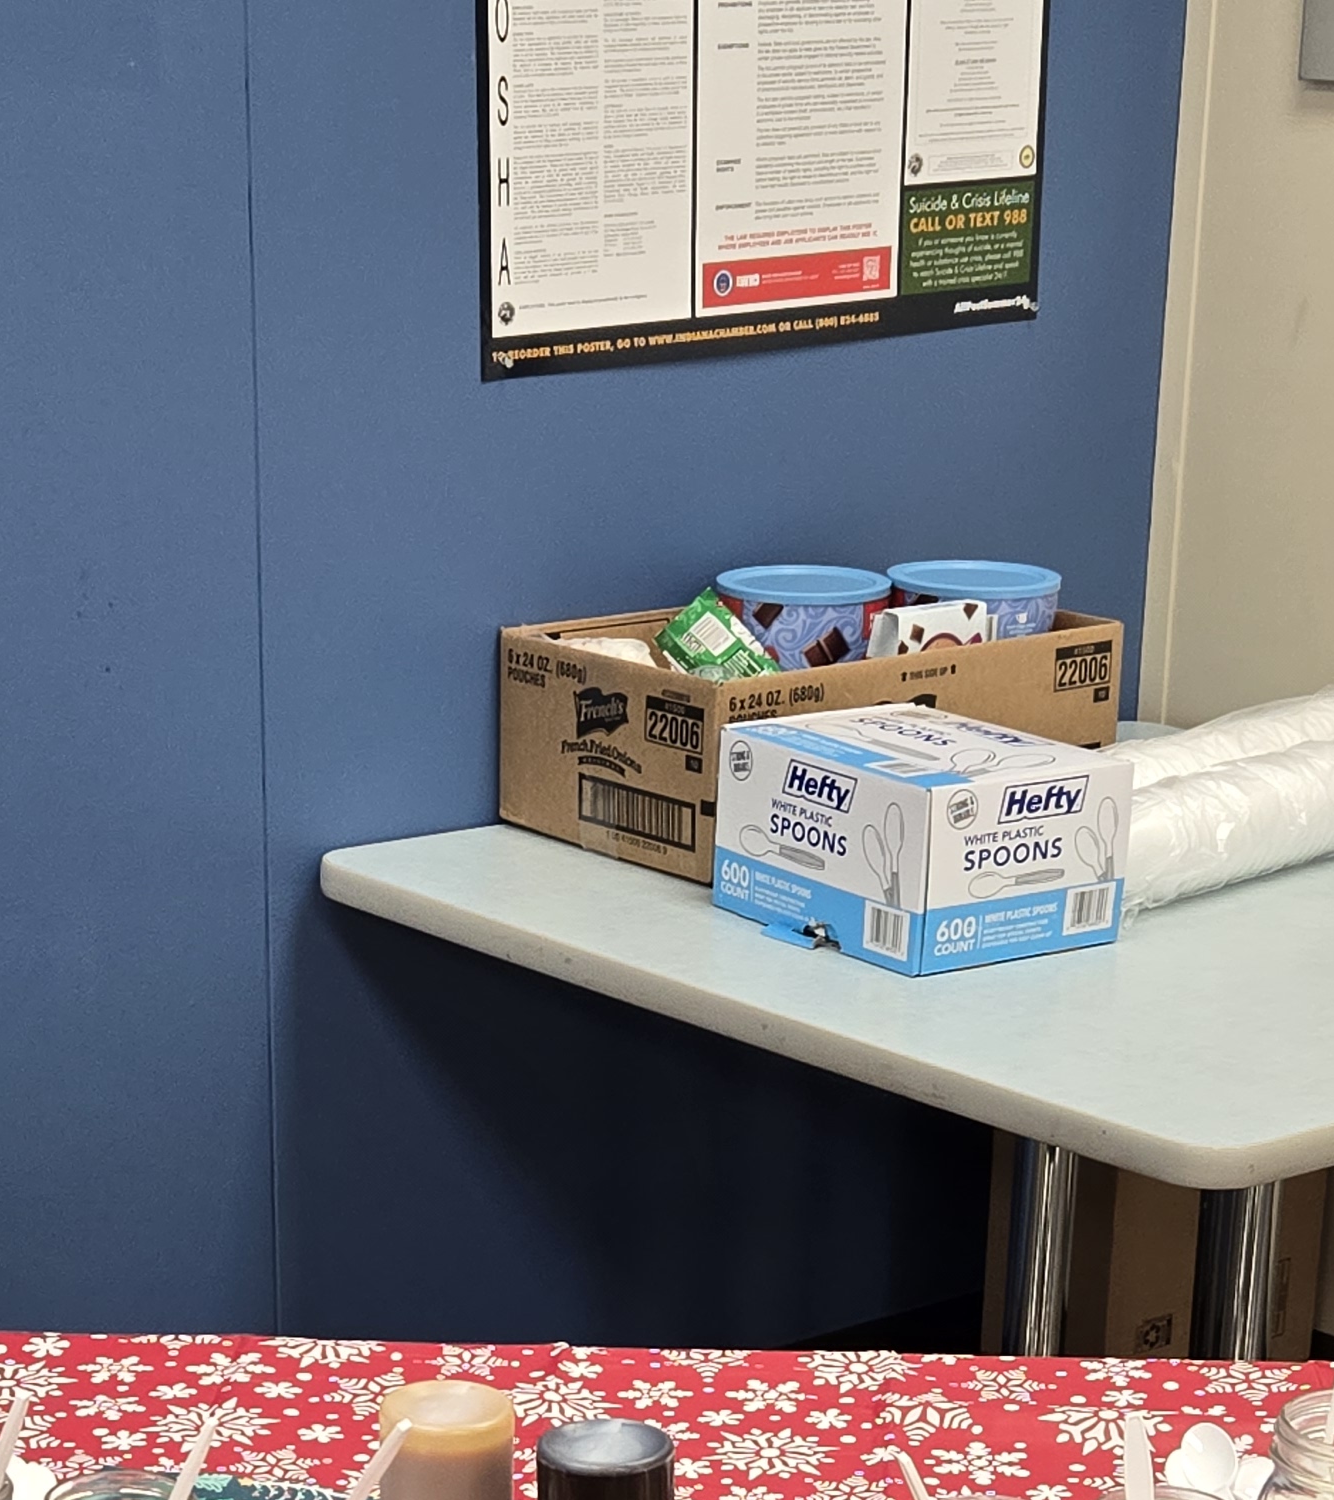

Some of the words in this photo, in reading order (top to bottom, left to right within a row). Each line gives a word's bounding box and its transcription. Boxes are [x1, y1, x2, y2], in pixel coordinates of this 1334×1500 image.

[909, 195, 947, 214] Suicide
[950, 194, 959, 210] &
[962, 191, 991, 209] Crisis
[994, 188, 1030, 206] Lifeline
[910, 216, 942, 233] CALL
[945, 213, 965, 230] OR
[968, 210, 1000, 228] TEXT
[1003, 208, 1027, 225] 988
[553, 344, 575, 355] THIS
[577, 340, 614, 353] POSTER,
[617, 338, 631, 349] GO
[634, 336, 646, 347] TO
[778, 321, 791, 332] OR
[793, 318, 813, 331] CALL
[508, 649, 514, 662] 6
[522, 652, 535, 669] 24
[556, 660, 587, 685] (680g)
[508, 666, 546, 688] POUCHES
[1058, 655, 1108, 688] 22006
[579, 697, 624, 723] French's
[729, 696, 736, 712] 6
[748, 693, 763, 709] 24
[766, 689, 785, 708] OZ.
[789, 683, 825, 703] (680g)
[648, 710, 700, 750] 22006
[561, 739, 588, 754] French
[588, 739, 612, 758] Fried
[612, 746, 642, 774] Onions
[788, 765, 850, 810] Hefty
[1004, 785, 1082, 817] Hefty
[771, 797, 797, 817] WHITE
[799, 807, 832, 827] PLASTIC
[770, 814, 847, 857] SPOONS
[964, 830, 998, 846] WHITE
[1002, 825, 1045, 842] PLASTIC
[963, 837, 1063, 871] SPOONS
[721, 859, 749, 887] 600
[720, 881, 749, 900] COUNT
[936, 916, 976, 942] 600
[934, 939, 974, 956] COUNT
